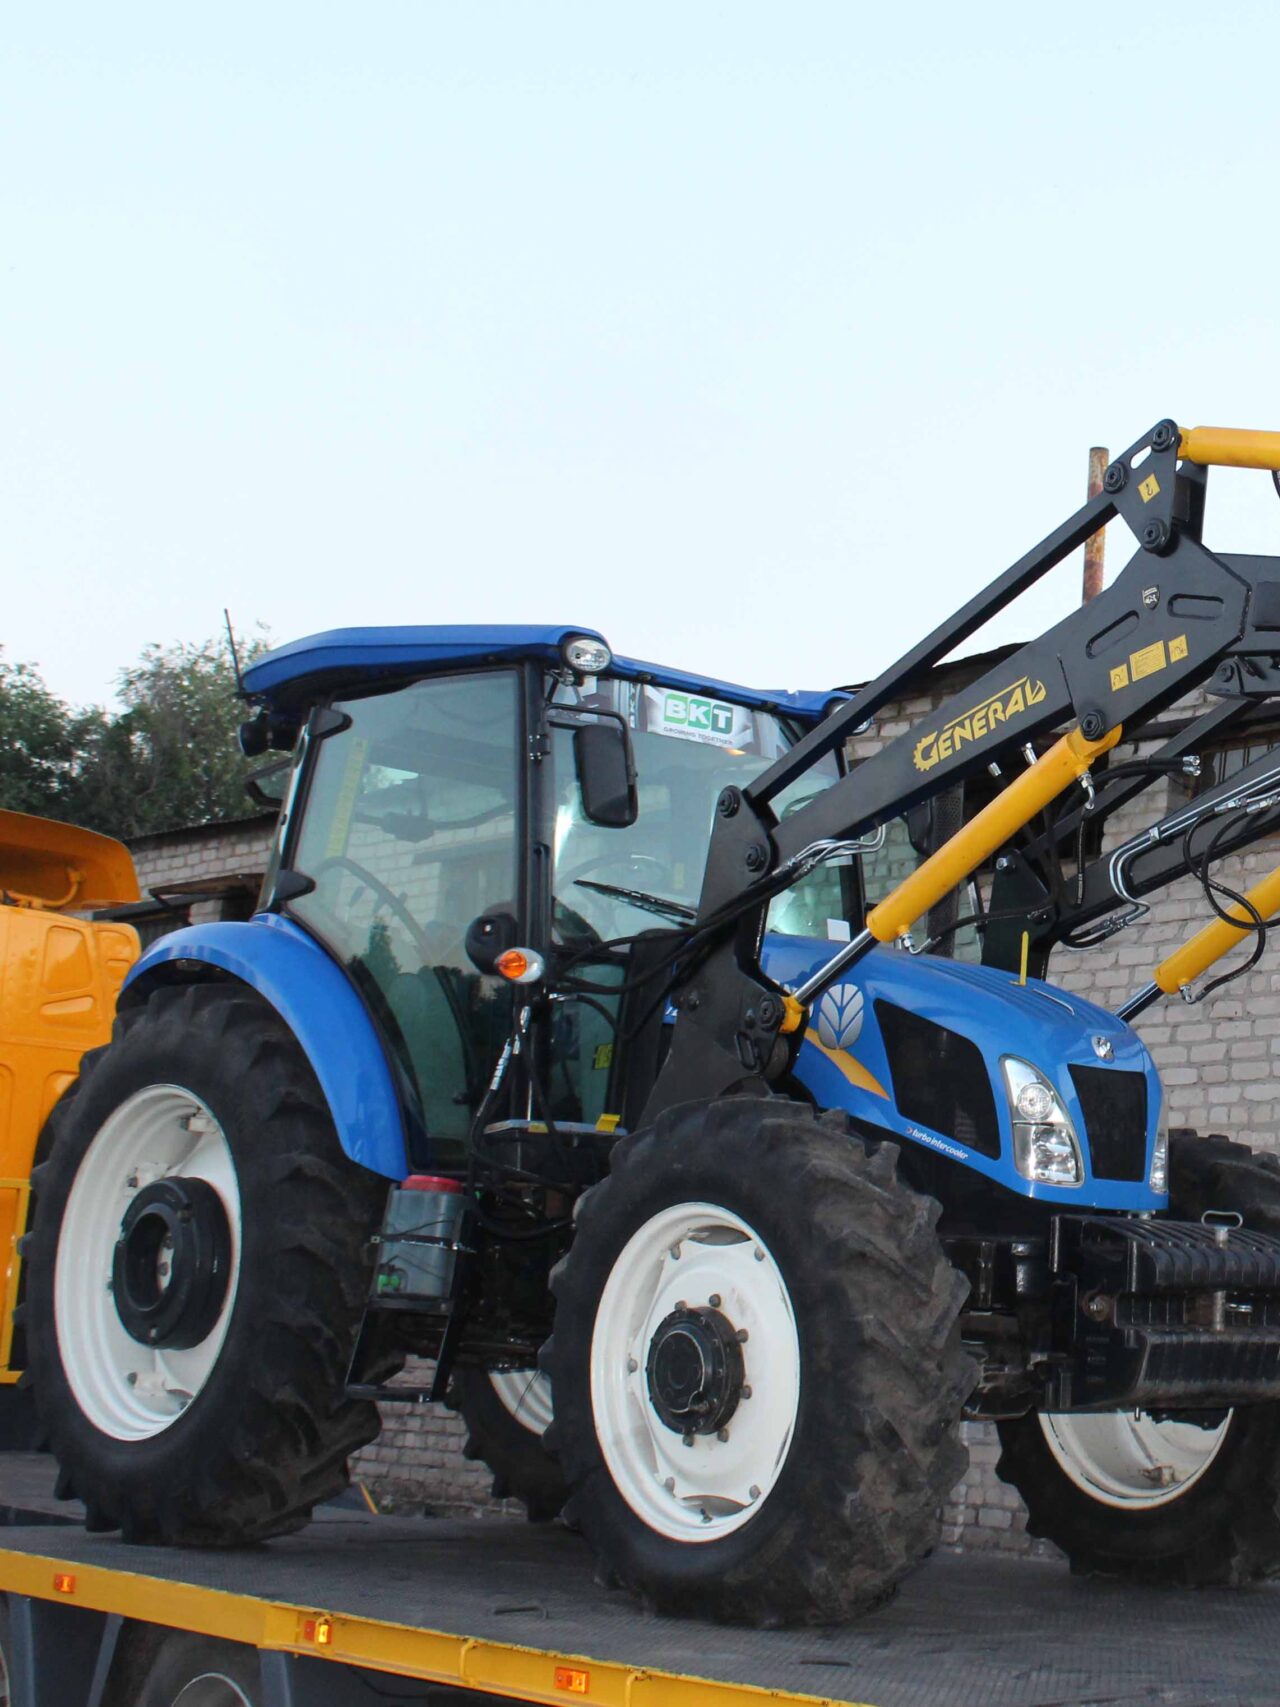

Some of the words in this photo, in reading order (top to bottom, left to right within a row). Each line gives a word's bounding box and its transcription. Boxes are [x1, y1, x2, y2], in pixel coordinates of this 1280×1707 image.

[664, 696, 733, 732] BKT
[912, 676, 1046, 771] GENERAL
[697, 732, 733, 745] TOGETHER
